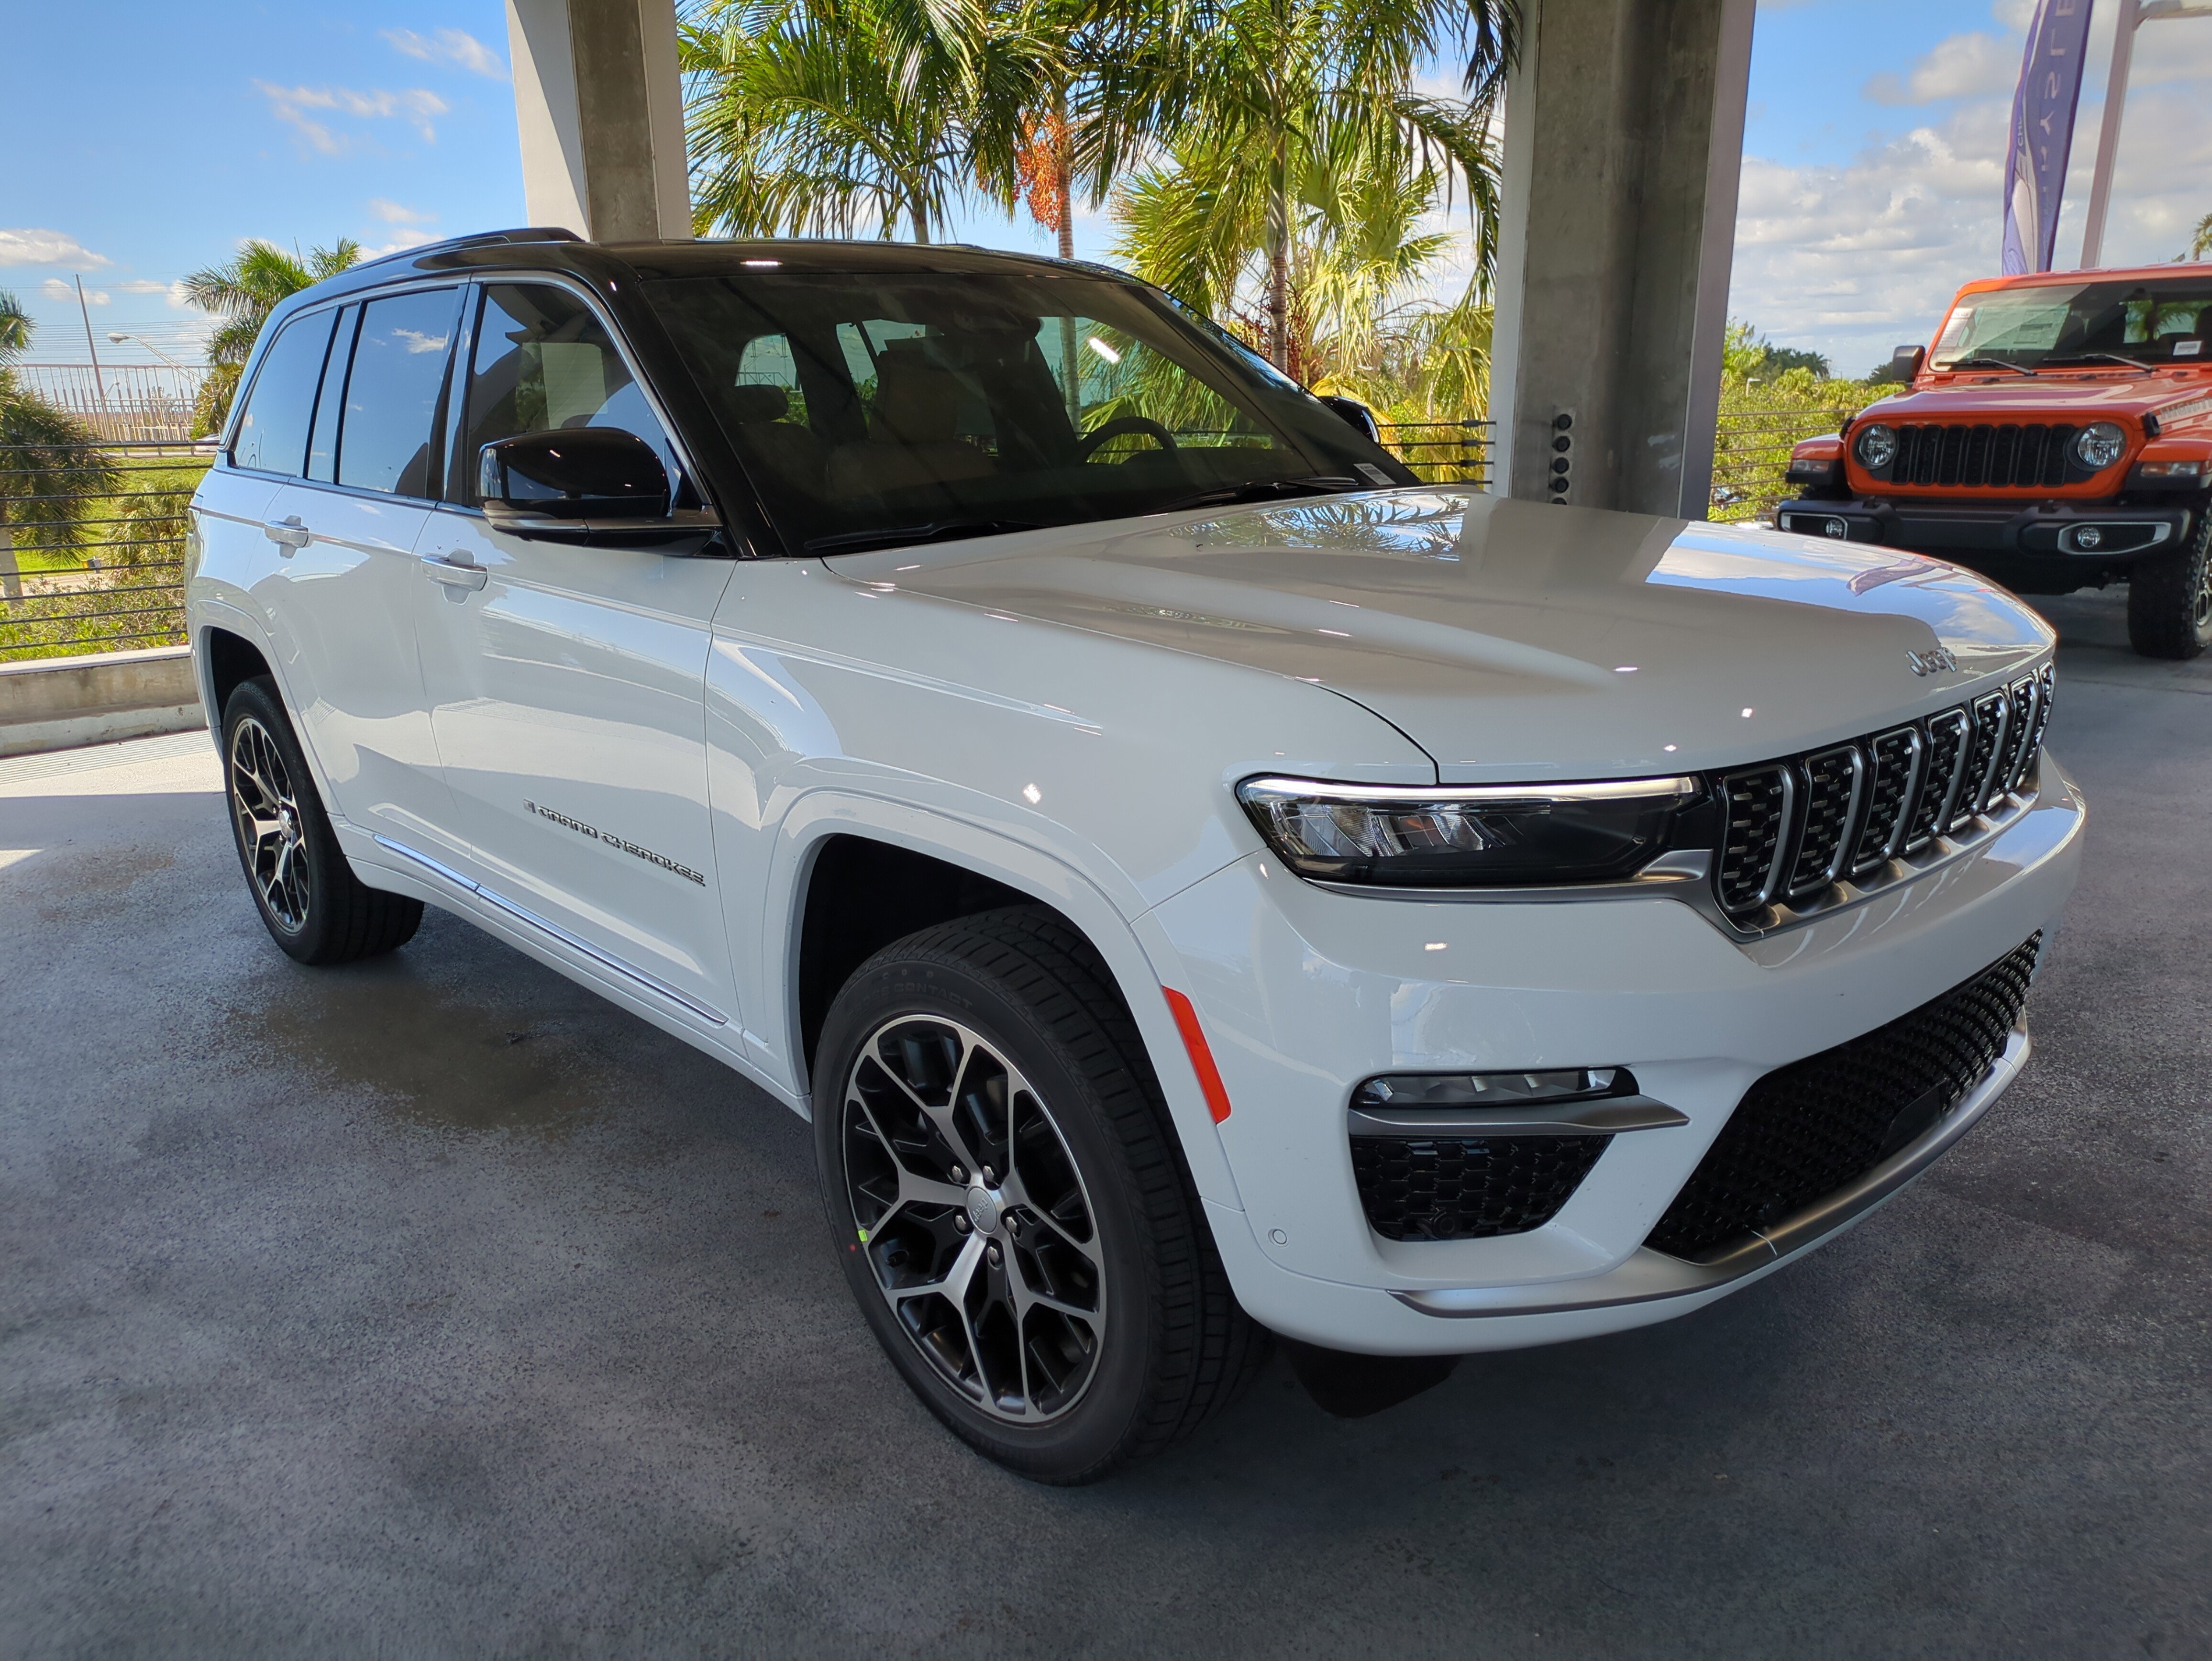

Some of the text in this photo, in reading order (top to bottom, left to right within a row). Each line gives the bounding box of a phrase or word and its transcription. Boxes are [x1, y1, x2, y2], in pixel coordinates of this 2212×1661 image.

[1906, 647, 1957, 676] Jeep
[537, 805, 706, 887] GRAND CHEROKEE
[894, 982, 973, 1009] CONTACT
